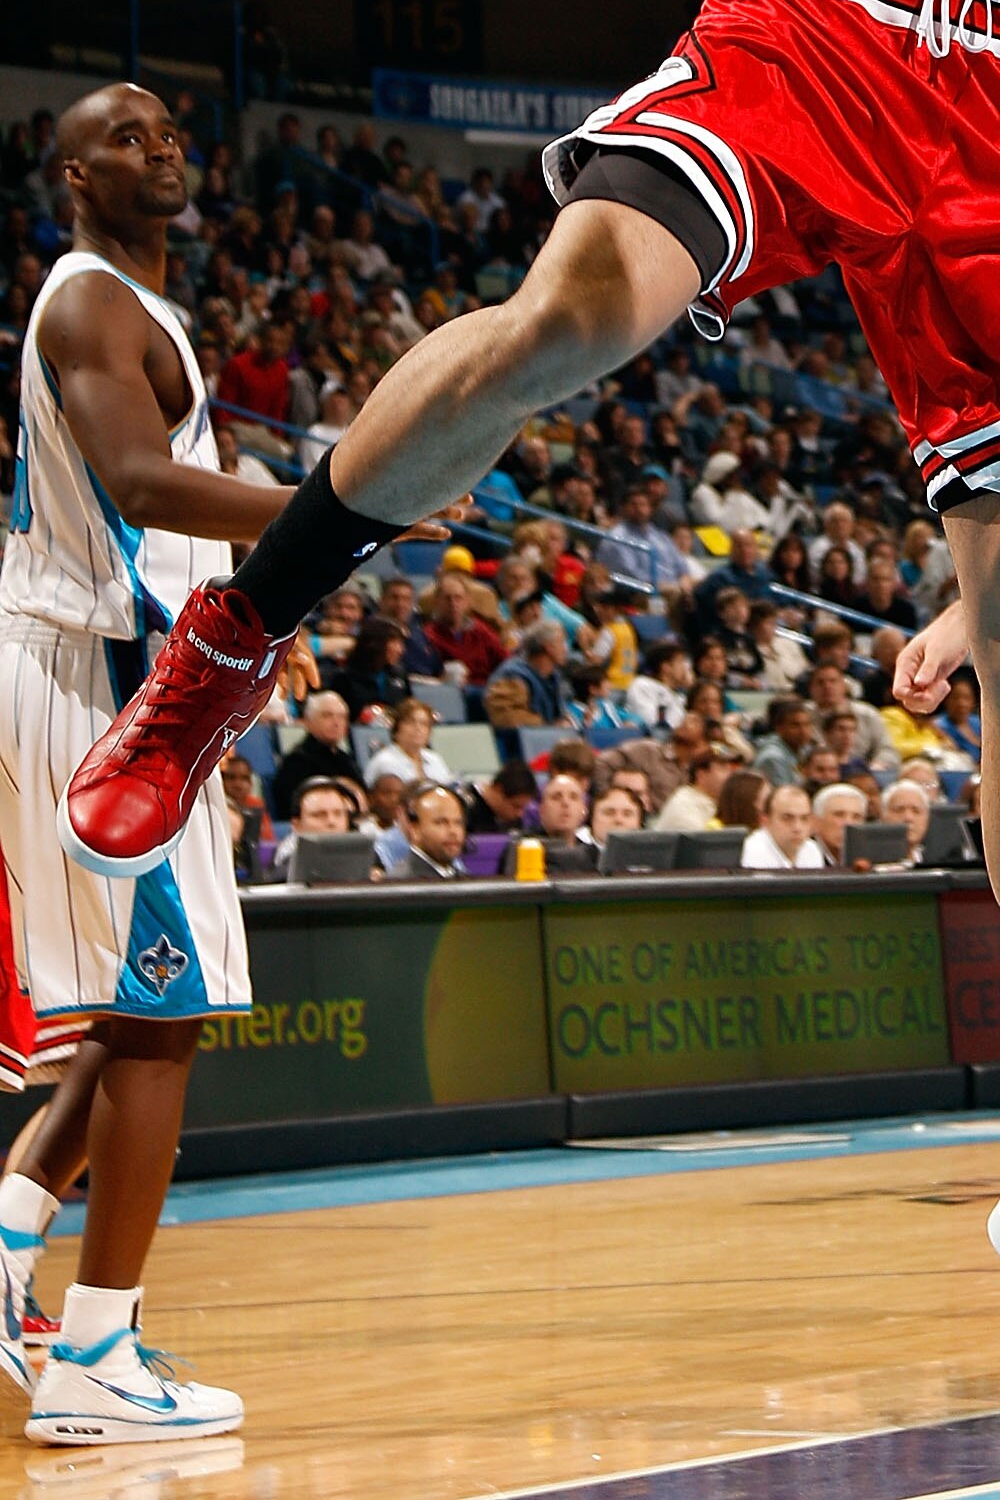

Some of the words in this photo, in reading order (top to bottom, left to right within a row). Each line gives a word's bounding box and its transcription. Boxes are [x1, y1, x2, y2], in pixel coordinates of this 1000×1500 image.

[186, 626, 196, 643] le
[194, 637, 213, 659] coq
[212, 650, 254, 671] sportif
[554, 945, 623, 987] ONE
[632, 942, 673, 983] OF
[845, 933, 900, 973] TOP
[557, 995, 761, 1059] OCHSNER
[775, 985, 944, 1045] MEDICAL
